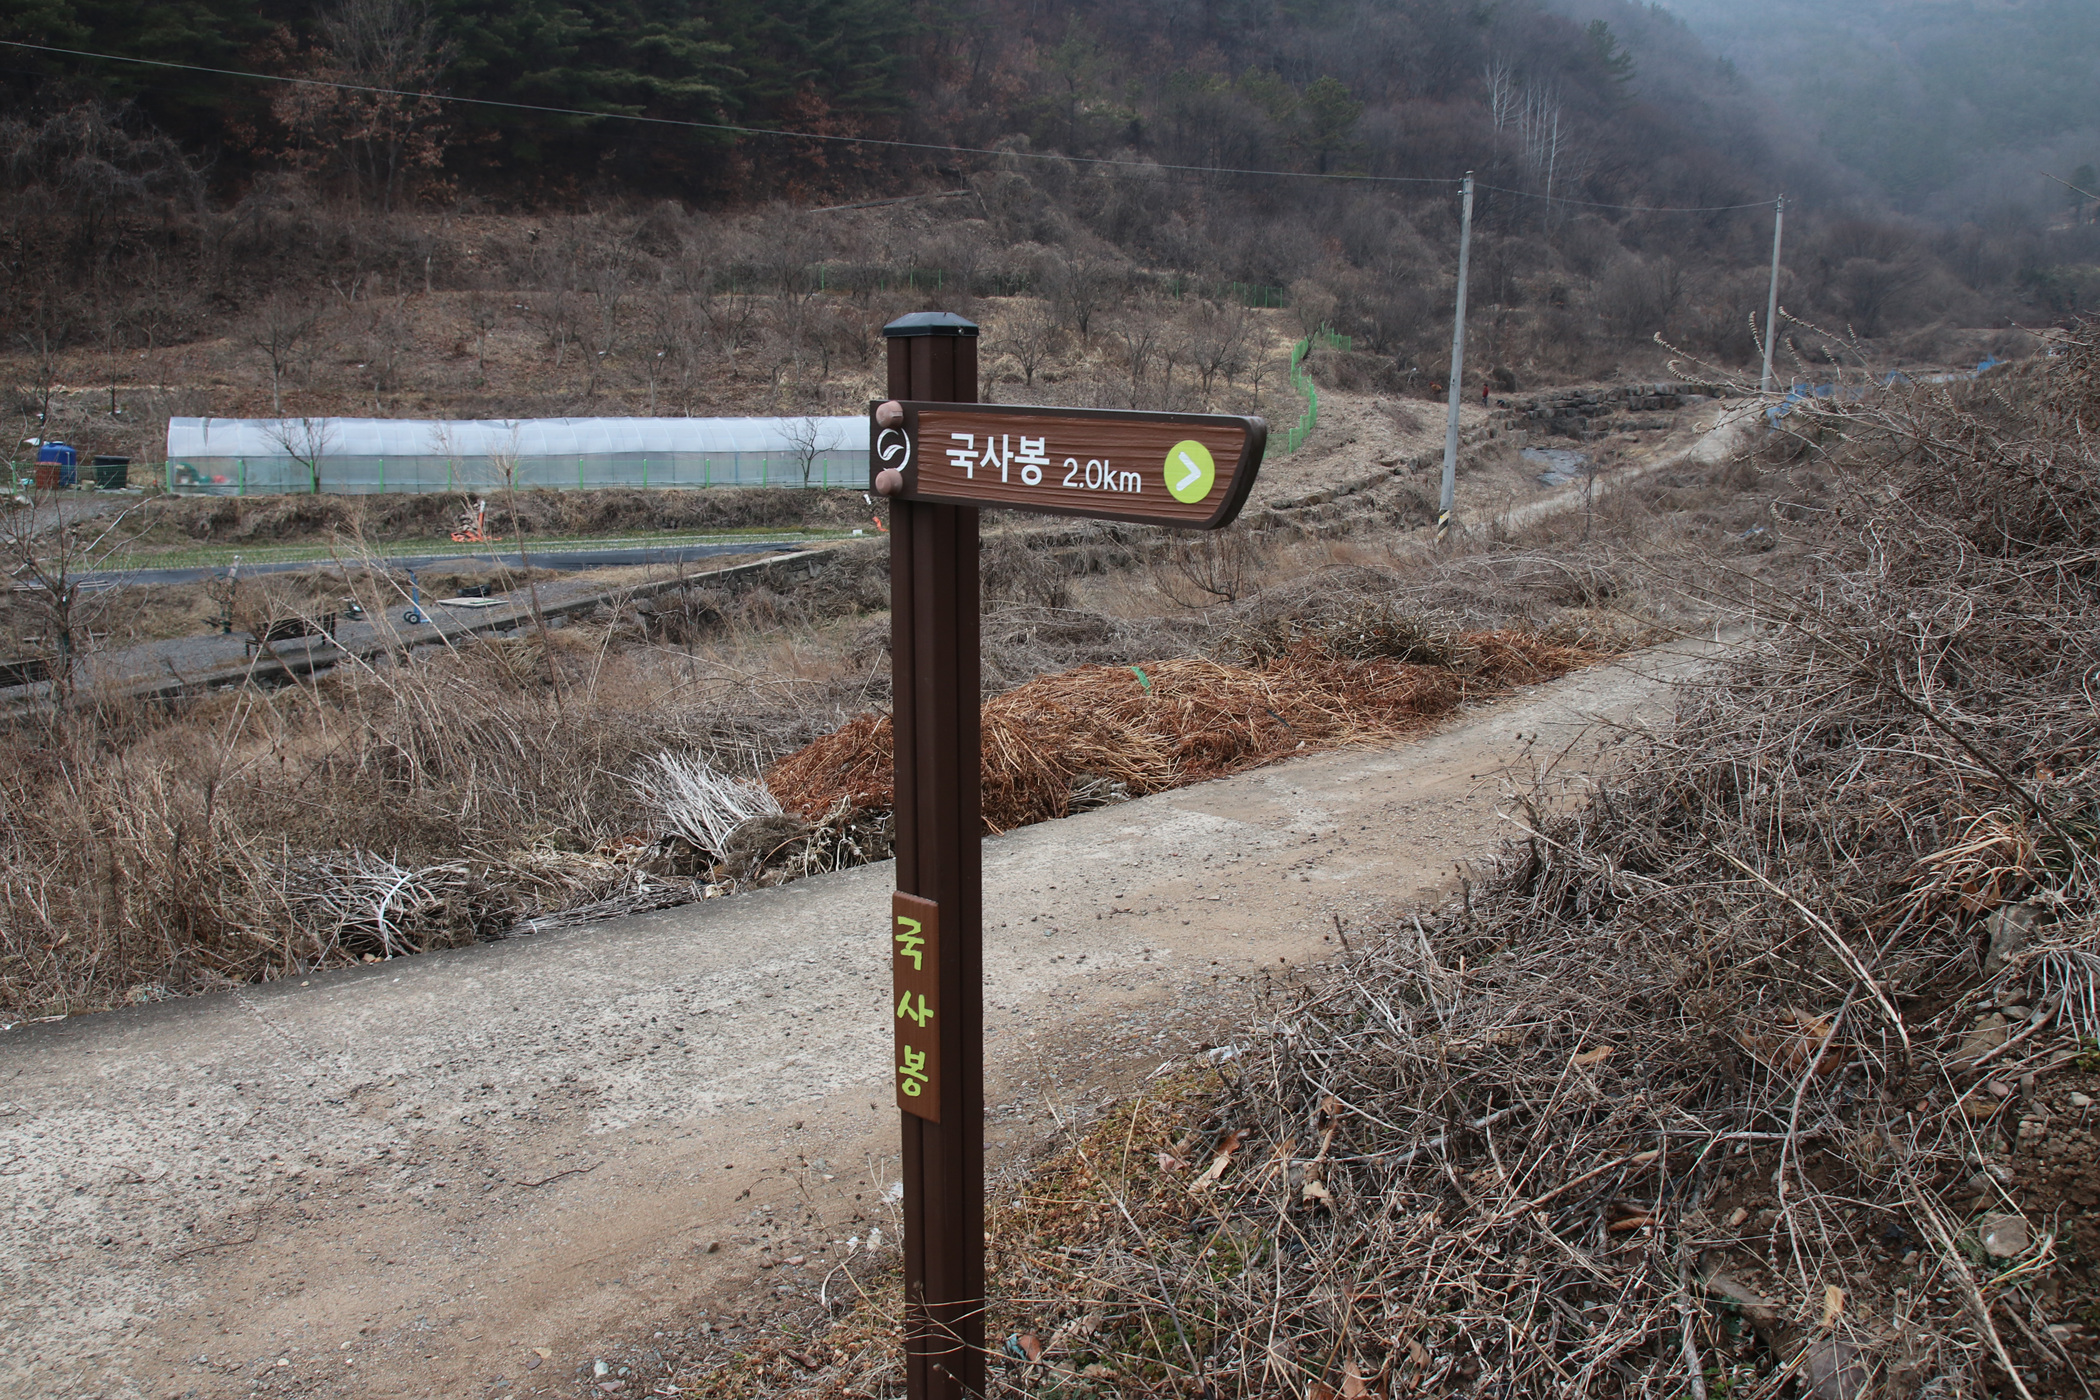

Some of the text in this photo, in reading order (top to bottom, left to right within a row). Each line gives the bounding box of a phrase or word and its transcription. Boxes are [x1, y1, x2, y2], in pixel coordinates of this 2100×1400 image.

[945, 432, 1142, 494] 국사봉 2.0km
[895, 915, 935, 1097] 국사봉
